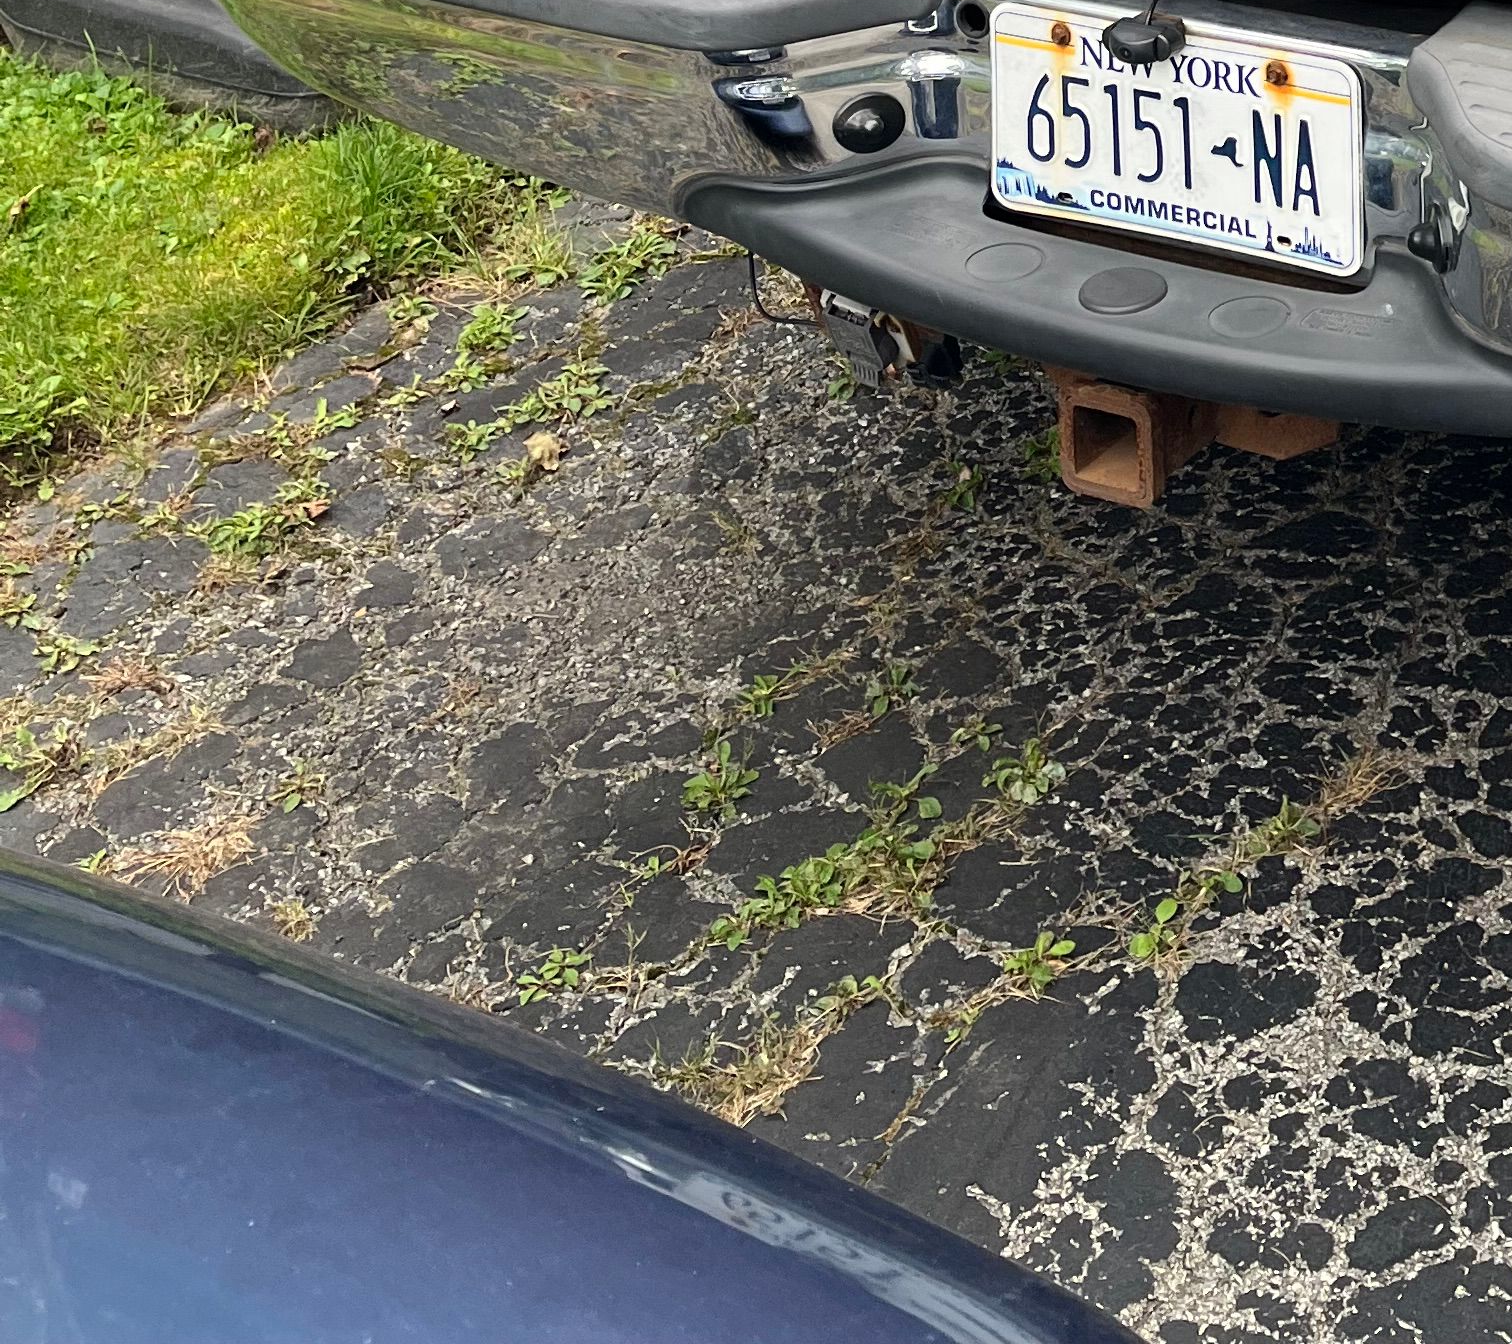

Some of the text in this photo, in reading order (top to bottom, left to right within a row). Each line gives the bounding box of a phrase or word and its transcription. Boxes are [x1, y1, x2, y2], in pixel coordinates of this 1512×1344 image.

[1169, 54, 1262, 98] YORK
[1027, 73, 1320, 217] 65151 NA
[1090, 189, 1257, 239] COMMERCIAL
